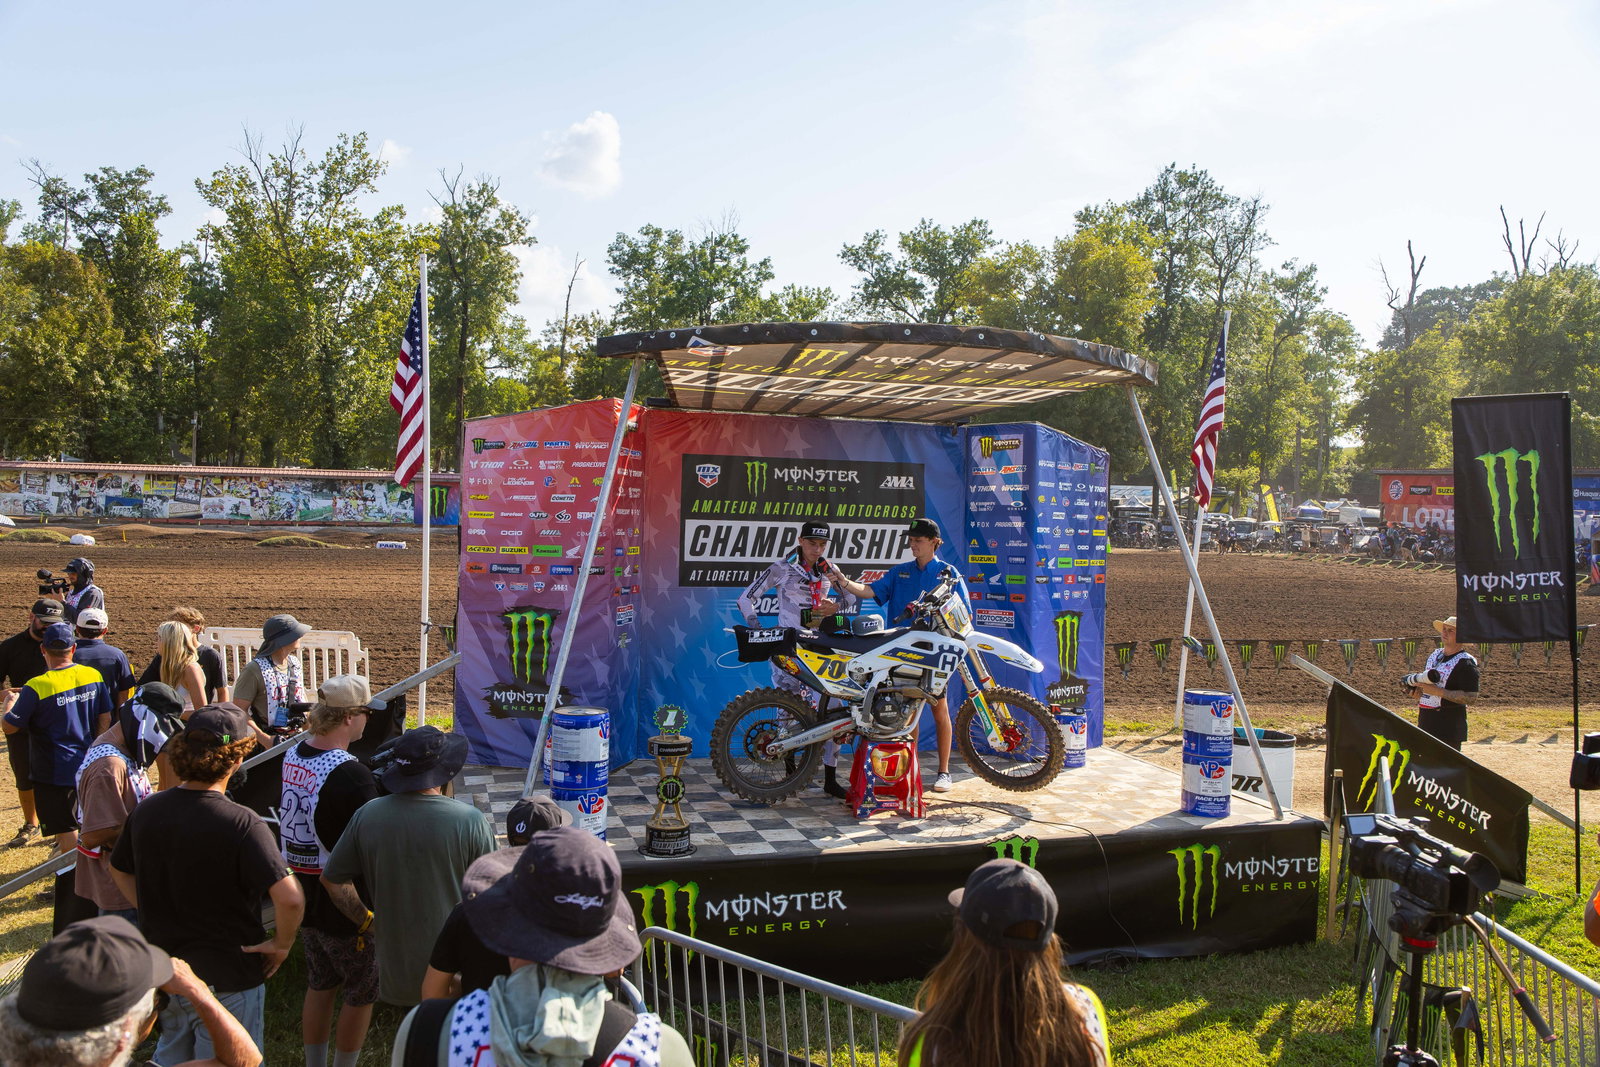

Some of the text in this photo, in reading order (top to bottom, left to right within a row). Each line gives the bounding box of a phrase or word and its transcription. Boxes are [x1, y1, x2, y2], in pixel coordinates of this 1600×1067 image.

[774, 466, 860, 483] MONSTER
[879, 475, 915, 489] AMA
[787, 485, 847, 493] ENERGY
[692, 499, 917, 519] AMATEUR NATIONAL MOTOCROSS
[689, 524, 911, 560] CHAMPNSHIP
[689, 569, 703, 581] AT
[706, 569, 750, 582] LORETTA
[1463, 570, 1564, 592] MONSTER
[1478, 592, 1550, 602] ENERGY
[977, 614, 1014, 622] MOTOCROSS
[1050, 685, 1084, 698] MONSTER
[1211, 700, 1228, 718] VP
[663, 710, 678, 726] 1
[1070, 720, 1085, 734] VP
[881, 754, 901, 777] 1
[1200, 761, 1219, 779] VP
[578, 792, 599, 814] VP
[1407, 769, 1492, 830] MONSTER
[1414, 798, 1477, 835] ENERGY
[1224, 855, 1320, 880] MONSTE
[1242, 880, 1318, 892] ENERGY
[705, 890, 847, 922] MONSTER
[729, 919, 827, 936] ENERGY
